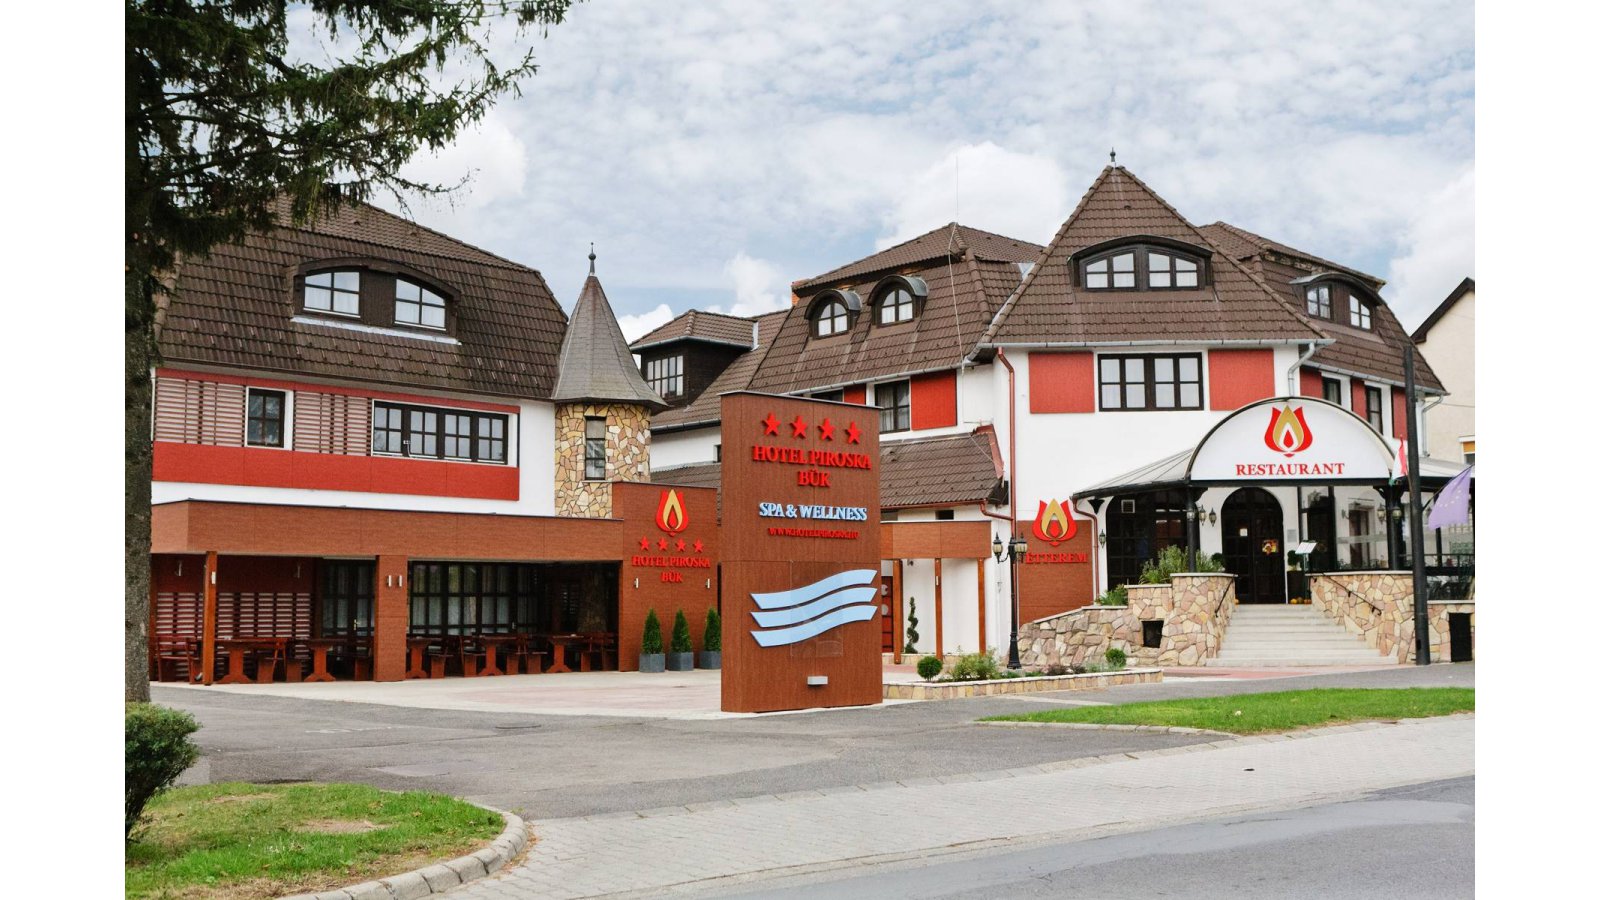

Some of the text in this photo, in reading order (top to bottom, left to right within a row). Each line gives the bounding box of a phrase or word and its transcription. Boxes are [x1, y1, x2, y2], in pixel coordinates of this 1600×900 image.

[753, 445, 872, 470] HOTEL PIROSKA
[798, 468, 831, 487] BÜK
[1235, 463, 1345, 477] RESTAURANT
[759, 502, 868, 521] SPA & WELLNESS
[632, 555, 711, 569] HOTEL PIROSKA
[661, 570, 683, 583] BÜK
